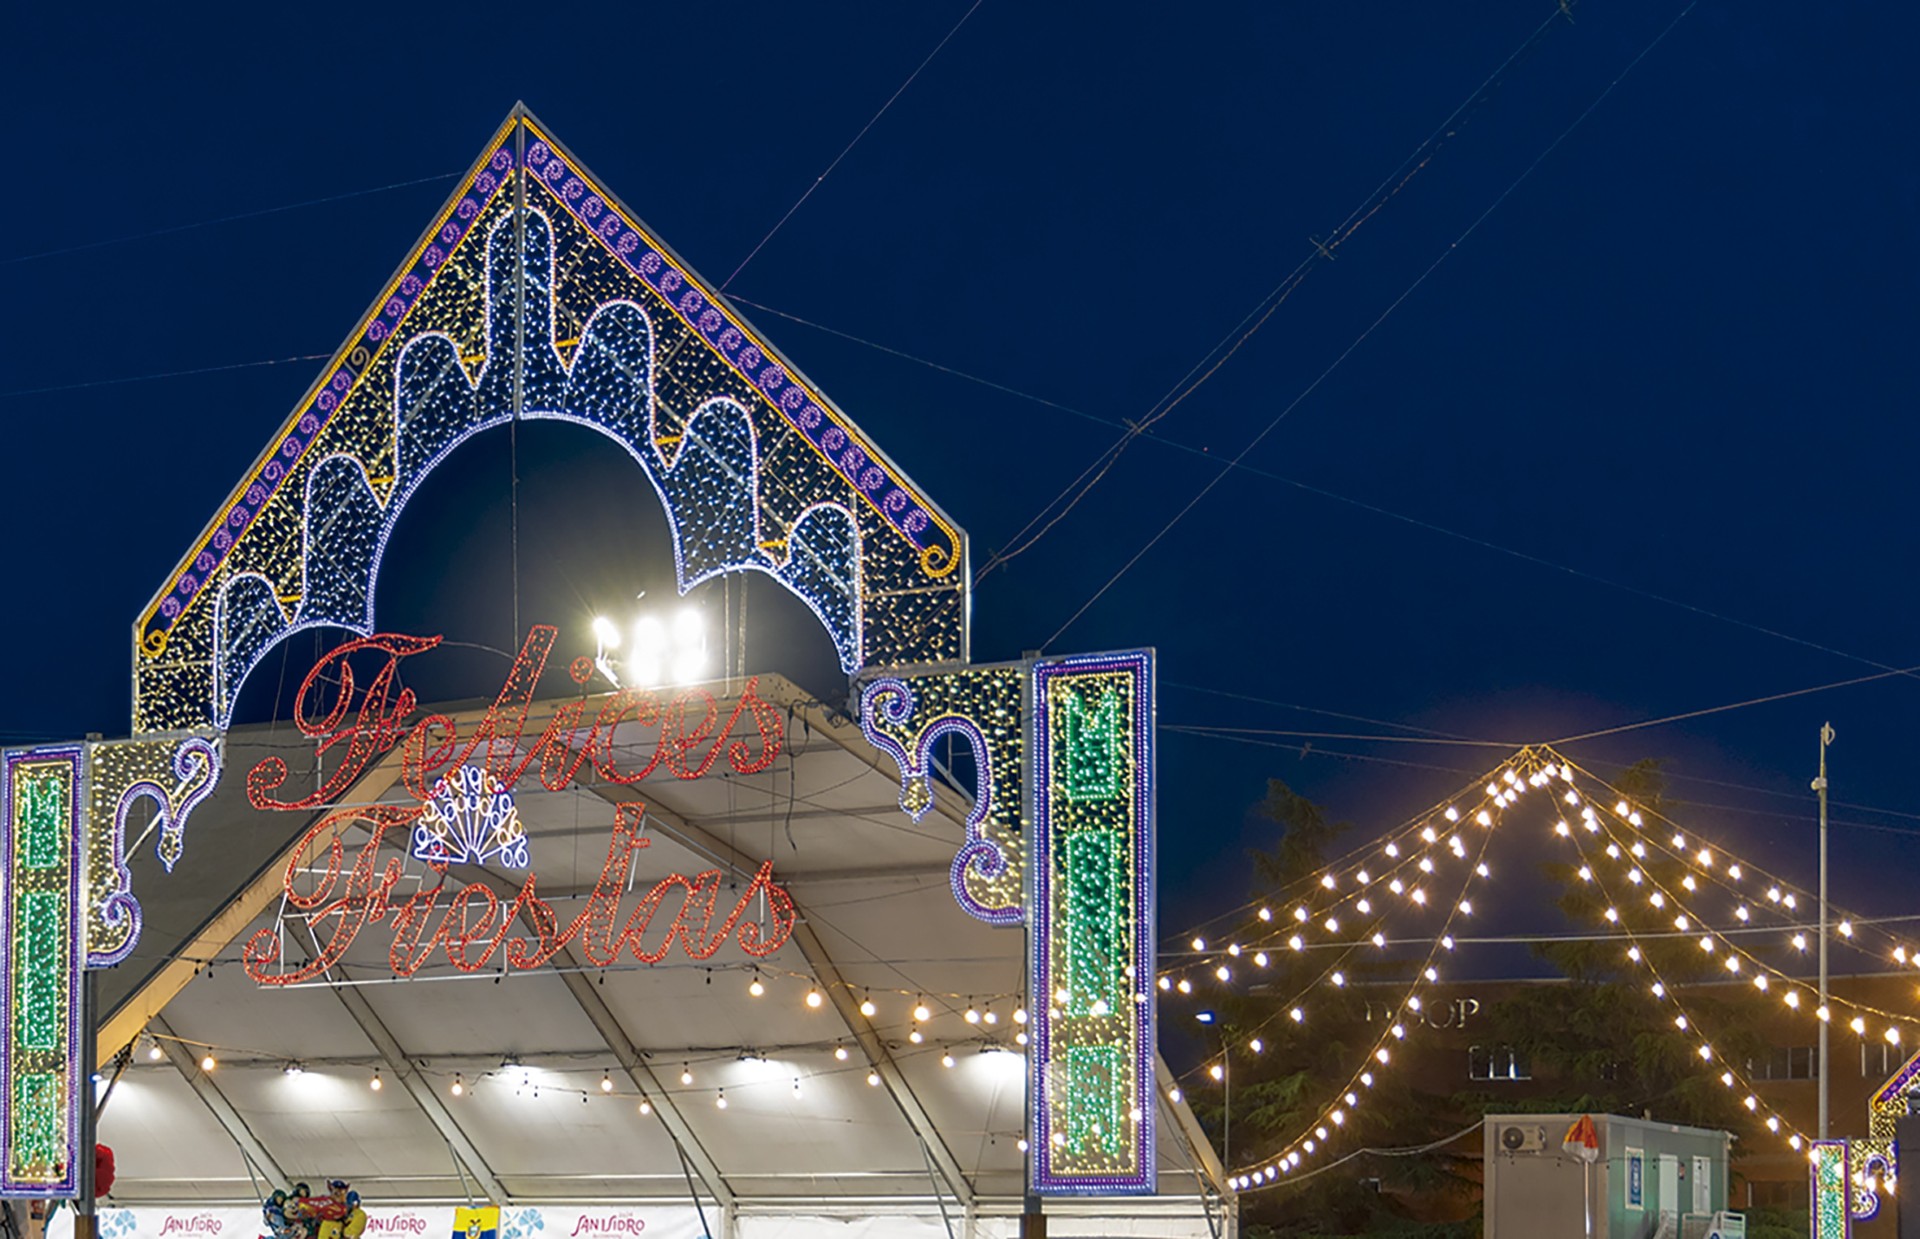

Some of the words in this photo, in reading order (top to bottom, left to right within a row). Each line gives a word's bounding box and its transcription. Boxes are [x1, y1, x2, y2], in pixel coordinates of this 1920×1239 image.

[247, 625, 783, 810] Felices
[243, 802, 796, 985] Fiestas
[159, 1216, 183, 1236] SAN
[367, 1215, 384, 1232] AN
[570, 1215, 599, 1237] SAN
